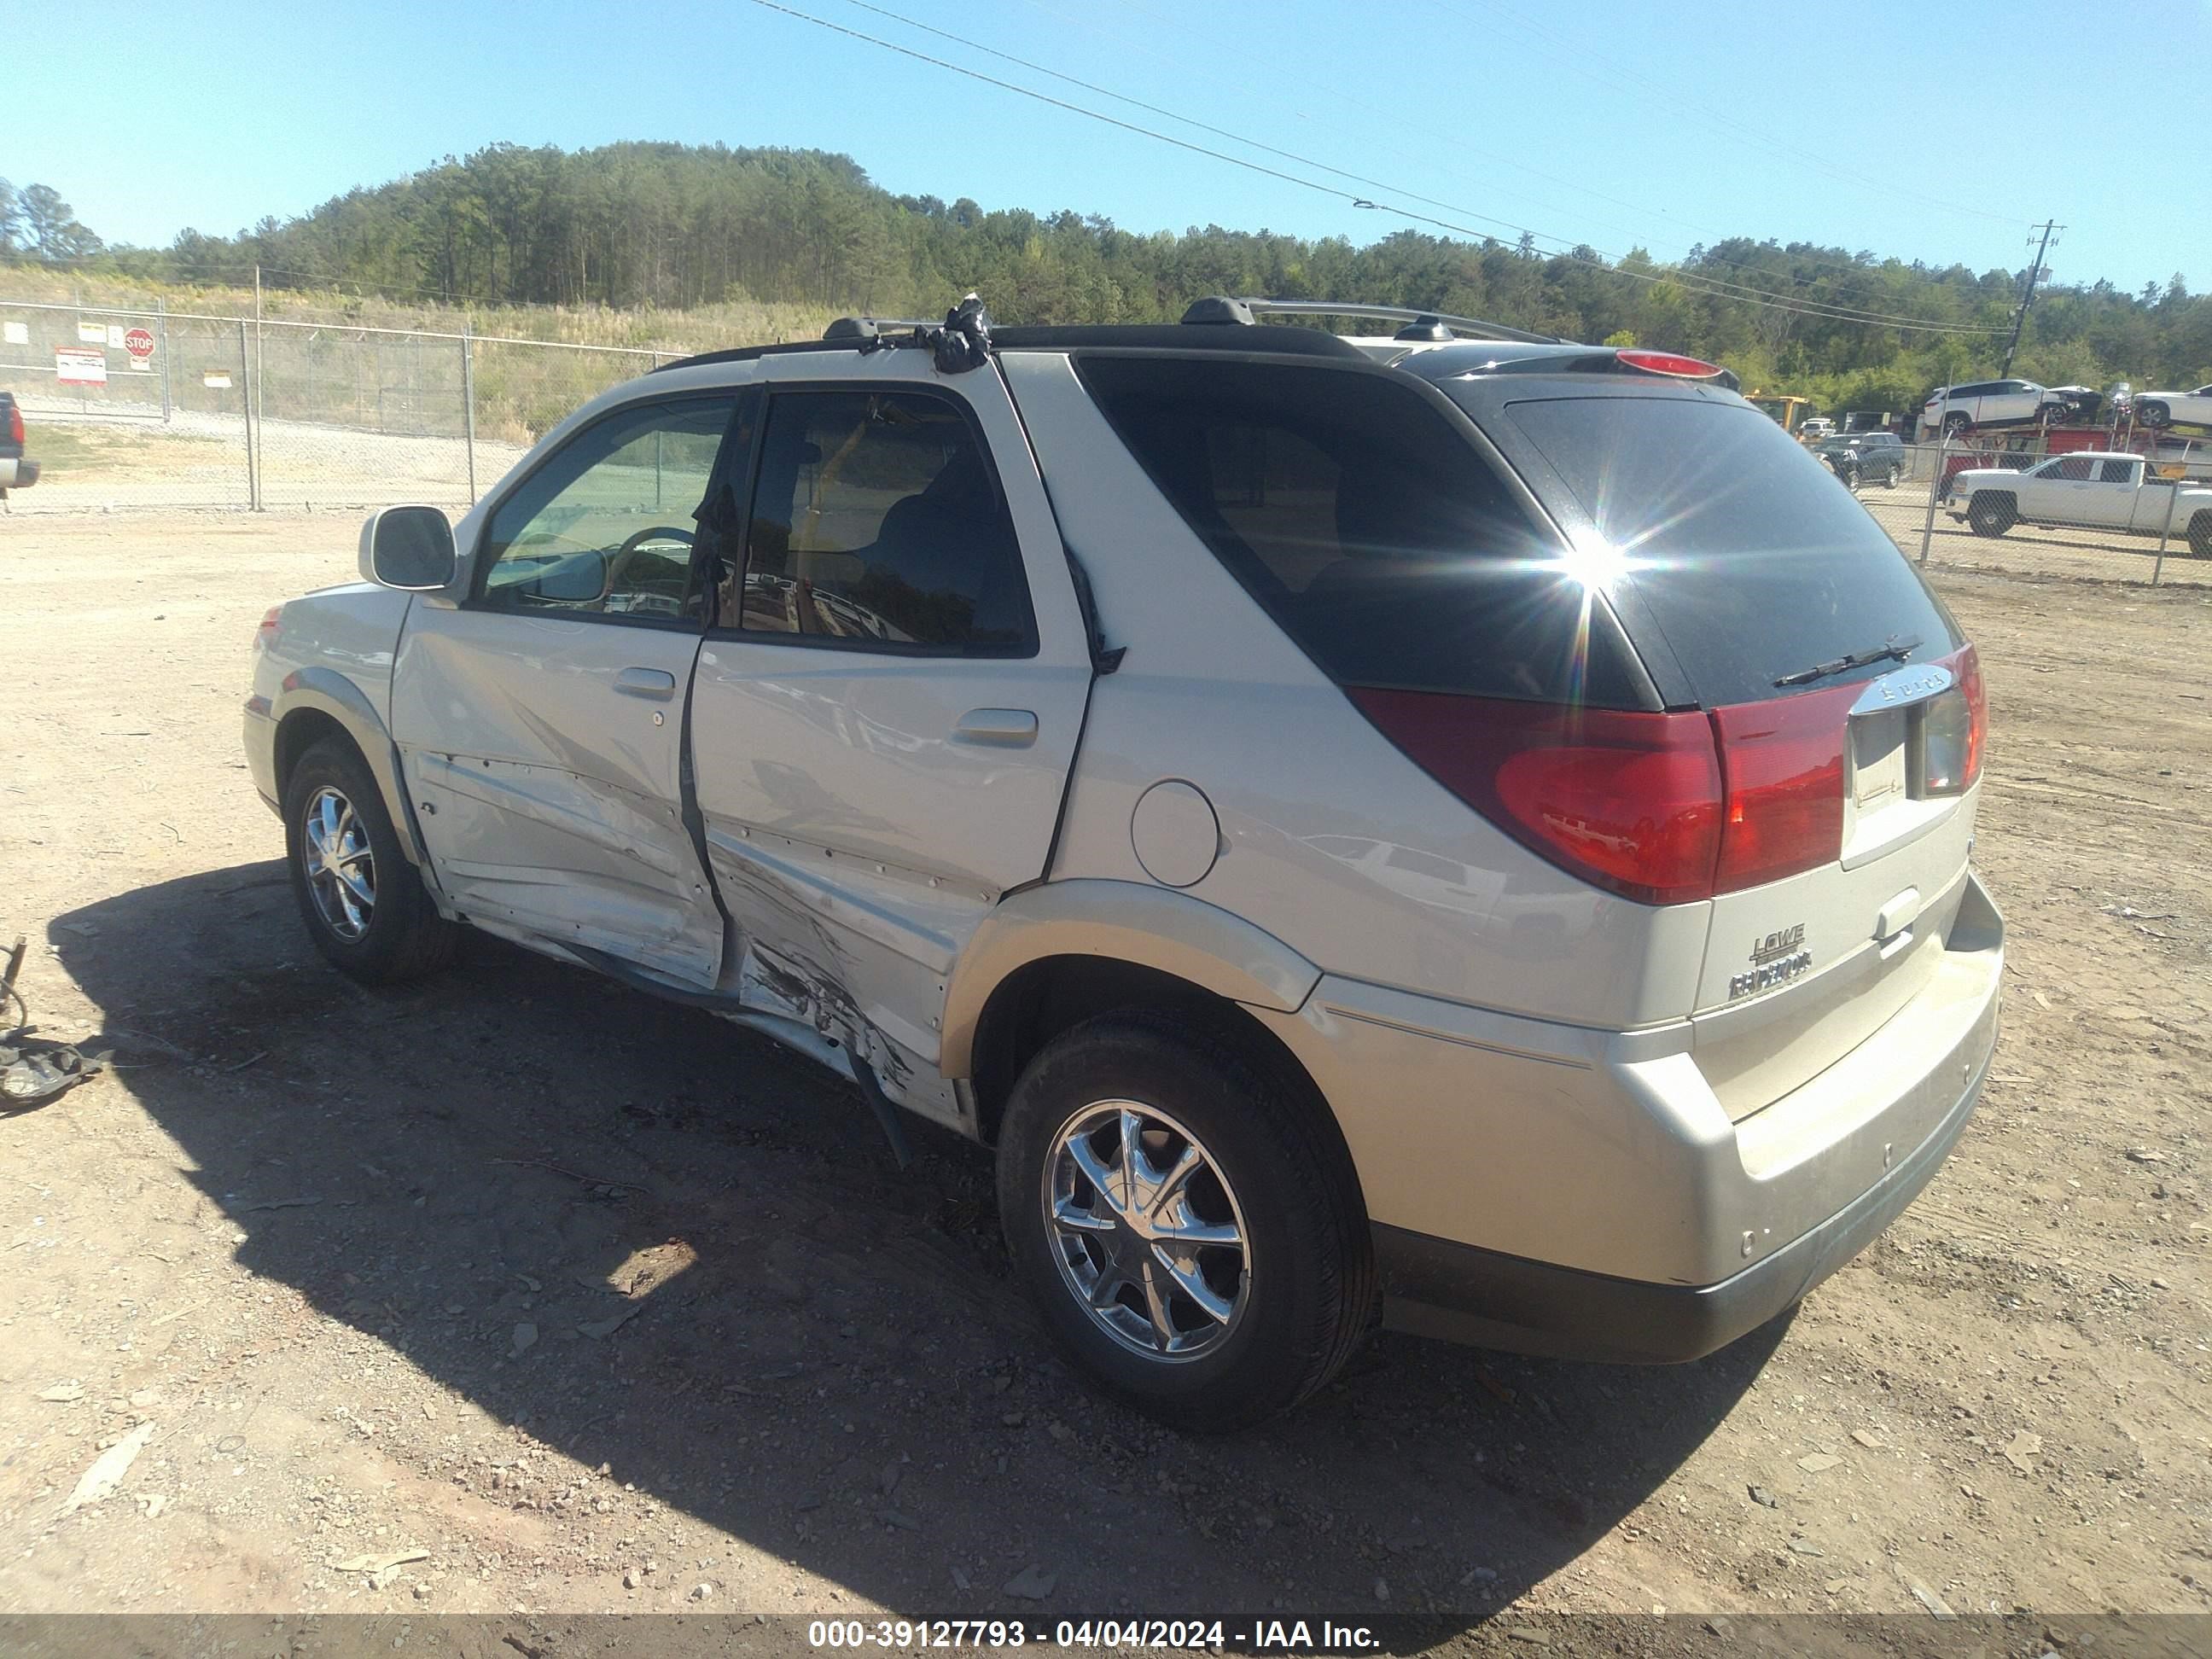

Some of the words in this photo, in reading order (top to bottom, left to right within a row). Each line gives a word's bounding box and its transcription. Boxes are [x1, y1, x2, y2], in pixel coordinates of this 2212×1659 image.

[126, 336, 152, 350] STOP
[1879, 672, 1945, 701] BUICK
[1753, 923, 1805, 956] LOWE
